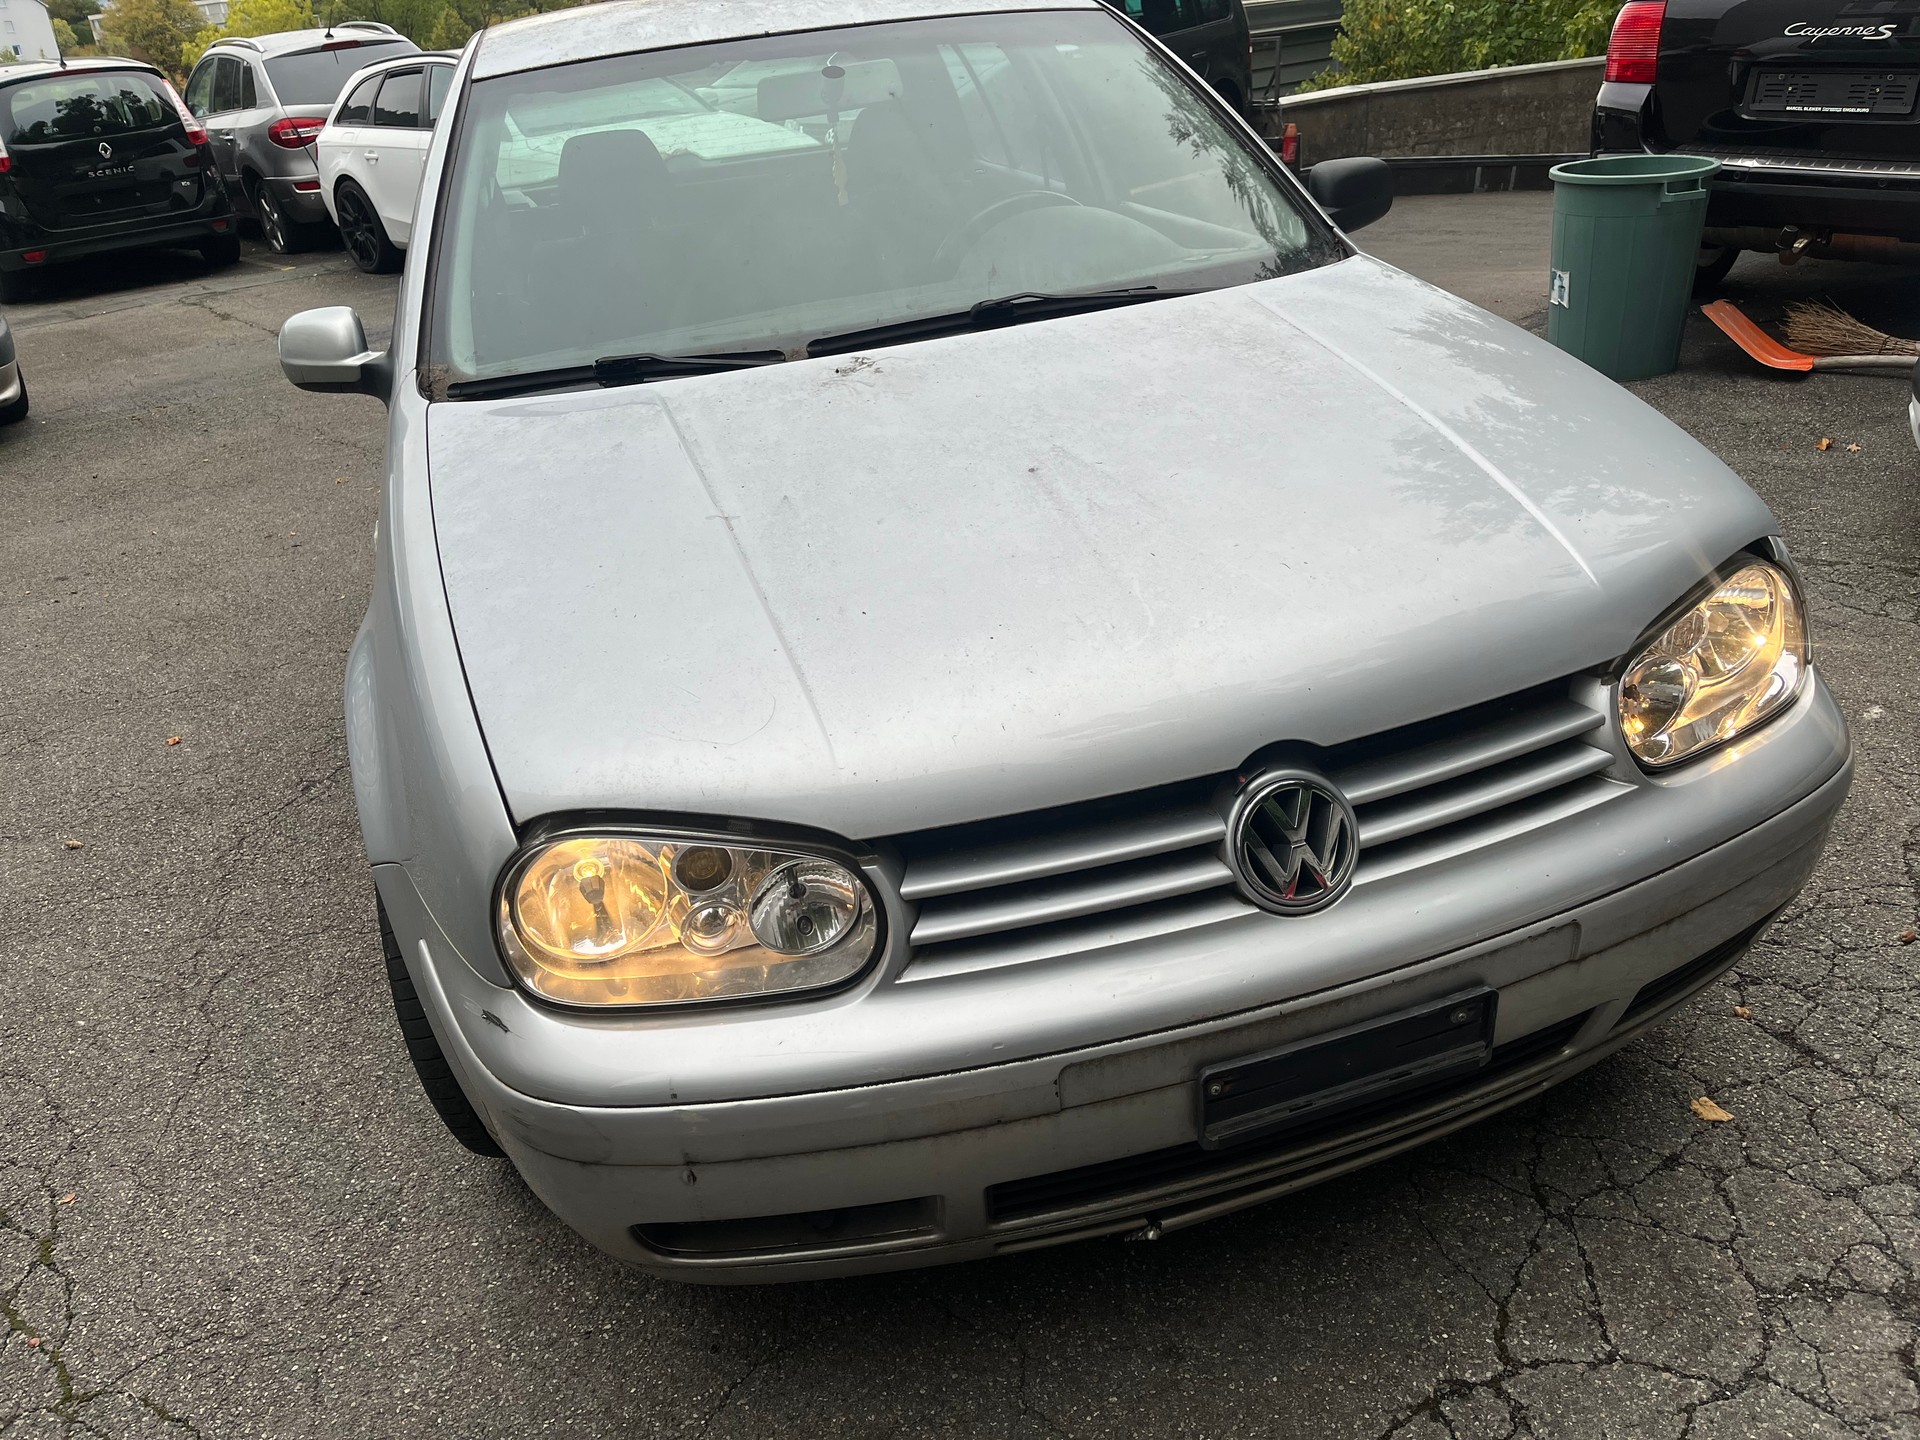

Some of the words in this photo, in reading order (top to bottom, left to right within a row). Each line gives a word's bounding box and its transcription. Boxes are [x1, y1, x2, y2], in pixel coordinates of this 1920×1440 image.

[1783, 21, 1876, 44] Cayenne
[1862, 24, 1898, 40] S
[87, 165, 135, 178] SCENIC
